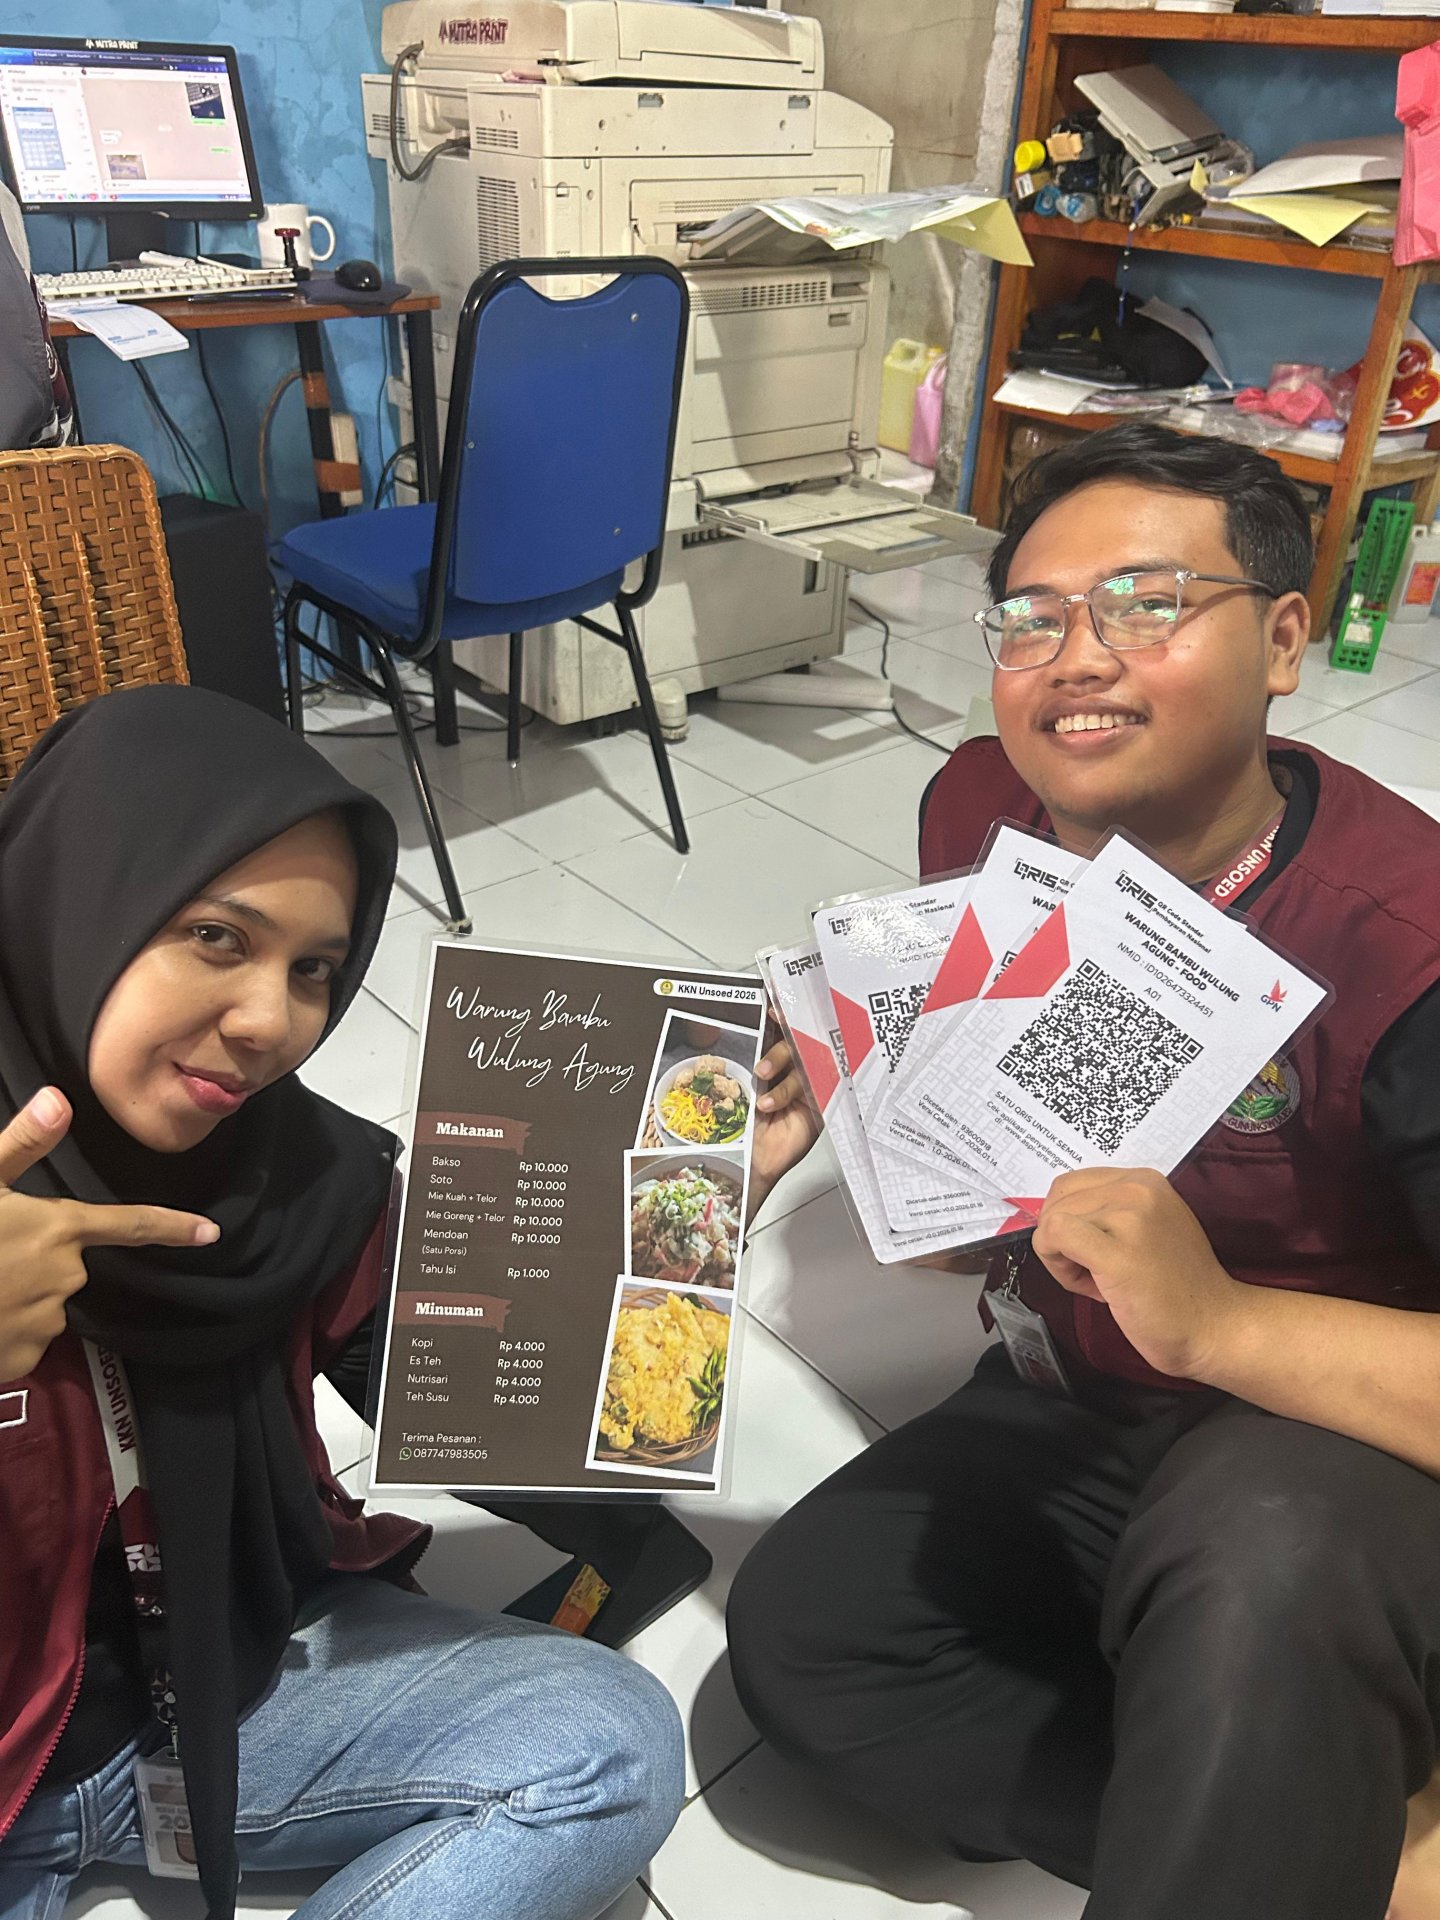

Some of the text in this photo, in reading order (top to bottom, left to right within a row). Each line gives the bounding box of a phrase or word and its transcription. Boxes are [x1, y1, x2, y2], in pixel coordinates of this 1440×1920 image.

[479, 18, 509, 44] PRINT
[1014, 862, 1059, 888] QRIS
[1214, 849, 1266, 897] UNSOED
[1115, 873, 1158, 909] QRIS
[1157, 901, 1204, 938] QR Code Standar
[1186, 933, 1212, 954] Nasional
[1125, 911, 1240, 1002] WARUNG BAMBU WULUNG
[1141, 940, 1176, 968] AGUNG
[1180, 968, 1207, 991] FOOD
[1117, 942, 1141, 963] NMID
[1144, 963, 1214, 1018] ID1026473324451
[678, 984, 756, 1000] KKN Unsoed 2026
[1144, 987, 1162, 1001] A01
[1260, 994, 1281, 1012] GPN
[446, 986, 611, 1038] Warung Bambu
[468, 1036, 636, 1094] Wulung Agung
[918, 1100, 933, 1115] Versi
[933, 1112, 950, 1128] Cetak
[987, 1101, 1000, 1114] Cek
[1000, 1112, 1027, 1134] aplikasi
[891, 1119, 916, 1135] Dicetak
[923, 1094, 945, 1114] Dicetak
[944, 1112, 958, 1125] oleh
[960, 1124, 992, 1151] 93600918
[995, 1090, 1083, 1164] SATU QRIS UNTUK SEMUA
[436, 1122, 504, 1138] Makanan
[889, 1126, 905, 1138] Versi
[906, 1134, 925, 1147] Cetak
[1005, 1125, 1057, 1169] www.aspi-qris.id
[432, 1156, 461, 1167] Bakso
[519, 1161, 569, 1173] Rp 10.000
[430, 1174, 453, 1185] Soto
[517, 1179, 567, 1191] Rp 10.000
[428, 1192, 444, 1200] Mie
[445, 1192, 467, 1201] Kuah
[476, 1194, 498, 1203] Telor
[515, 1197, 565, 1208] Rp 10.000
[426, 1210, 441, 1219] Mie
[444, 1211, 475, 1223] Goreng
[484, 1213, 506, 1222] Telor
[513, 1216, 563, 1227] Rp 10.000
[424, 1229, 469, 1240] Mendoan
[511, 1233, 561, 1244] Rp 10.000
[422, 1245, 467, 1256] (Satu Porsi)
[420, 1264, 457, 1275] Tahu Isi
[507, 1268, 550, 1279] Rp 1.000
[415, 1302, 484, 1317] Minuman
[411, 1338, 433, 1349] Kopi
[499, 1341, 545, 1352] Rp 4.000
[409, 1356, 441, 1366] Es Teh
[497, 1359, 543, 1370] Rp 4.000
[407, 1374, 449, 1384] Nutrisari
[495, 1376, 541, 1388] Rp 4.000
[406, 1392, 449, 1402] Teh Susu
[493, 1394, 539, 1405] Rp 4.000
[114, 1414, 136, 1454] KKN
[402, 1433, 434, 1442] Terima
[436, 1433, 477, 1444] Pesanan
[413, 1448, 488, 1460] 087747983505
